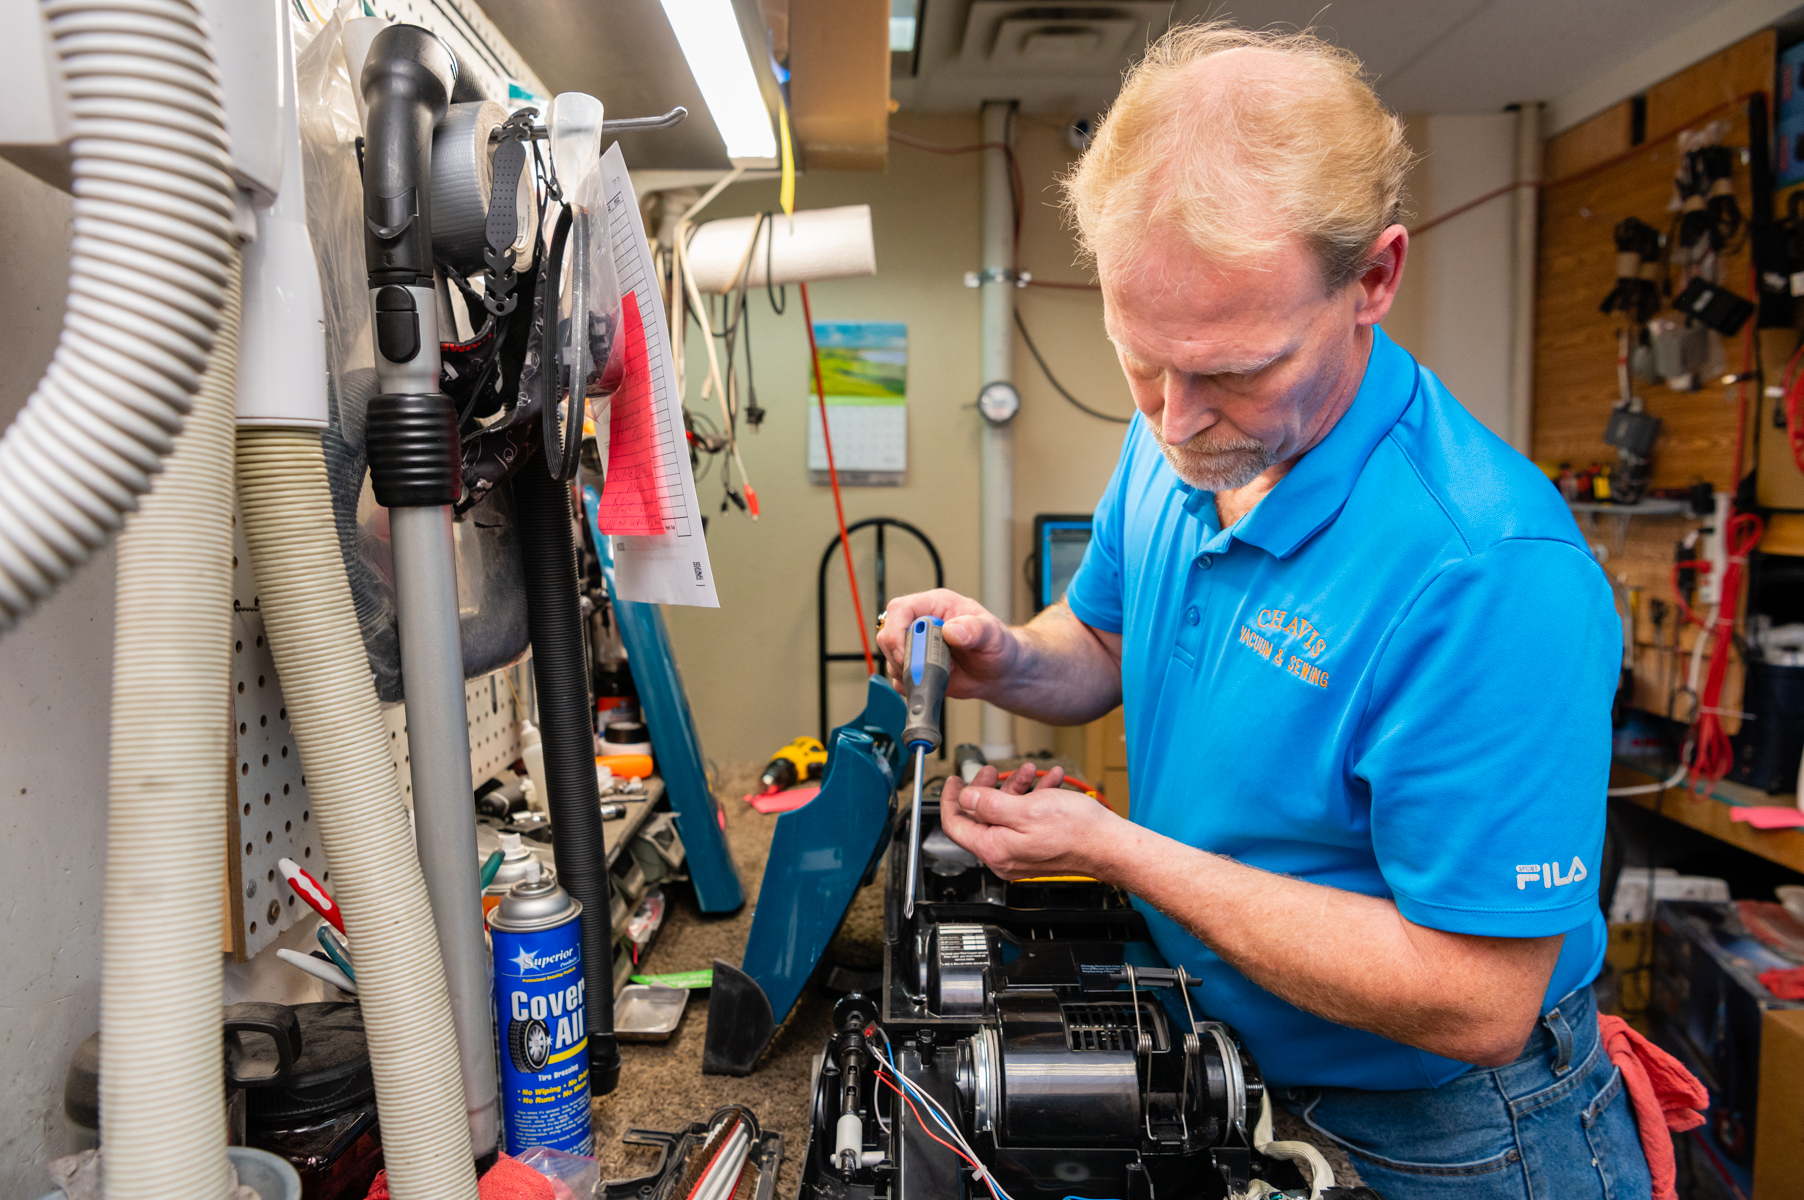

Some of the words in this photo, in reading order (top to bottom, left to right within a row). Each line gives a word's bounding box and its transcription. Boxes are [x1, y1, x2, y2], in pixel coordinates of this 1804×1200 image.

[1257, 609, 1327, 658] CHAVIS
[1240, 625, 1273, 659] VACUUM
[1274, 648, 1283, 666] &
[1287, 655, 1330, 688] SEWING
[1516, 856, 1587, 890] FILA
[523, 947, 573, 969] Superior
[511, 977, 585, 1021] Cover
[555, 1007, 585, 1049] All
[535, 1086, 561, 1096] Wiping
[568, 1079, 577, 1087] No
[554, 1064, 579, 1079] Dressing
[535, 1096, 555, 1104] Runs
[563, 1090, 573, 1098] No
